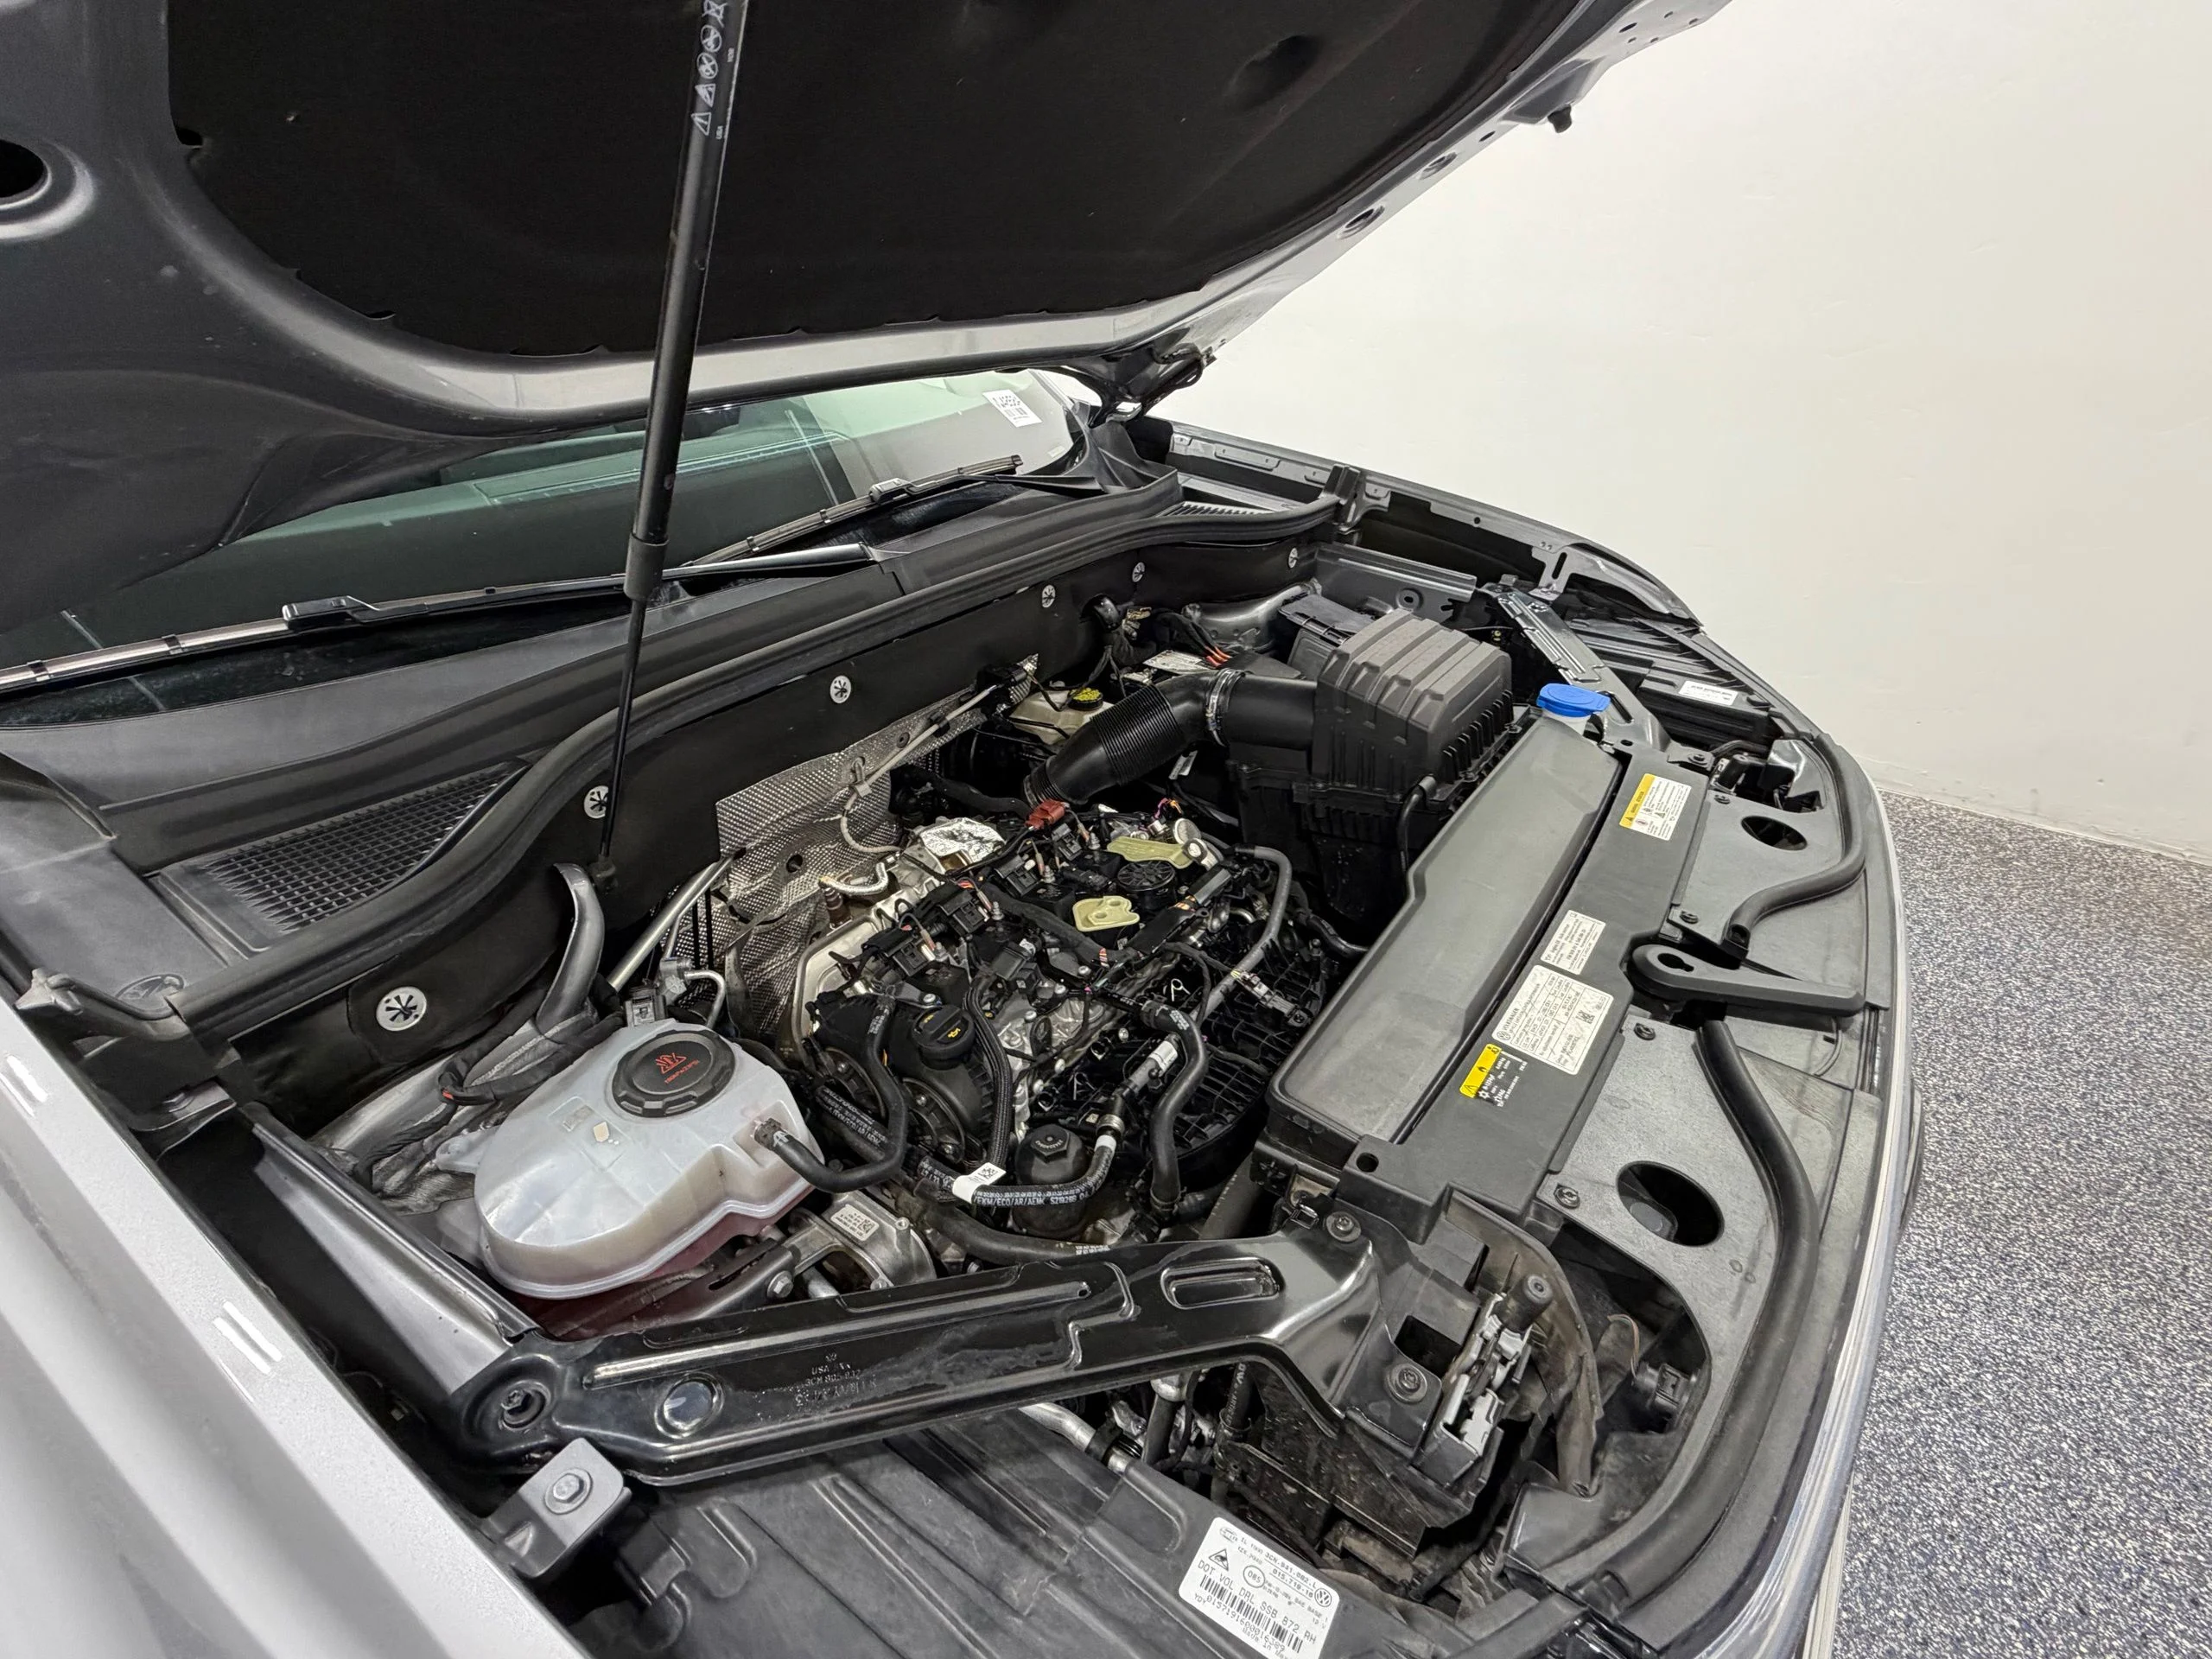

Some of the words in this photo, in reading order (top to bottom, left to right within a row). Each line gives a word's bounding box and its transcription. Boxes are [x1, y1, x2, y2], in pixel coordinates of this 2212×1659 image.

[1198, 1560, 1216, 1576] DOT
[1219, 1573, 1234, 1591] VOL
[1238, 1586, 1255, 1605] DRL
[1303, 1630, 1317, 1645] RH
